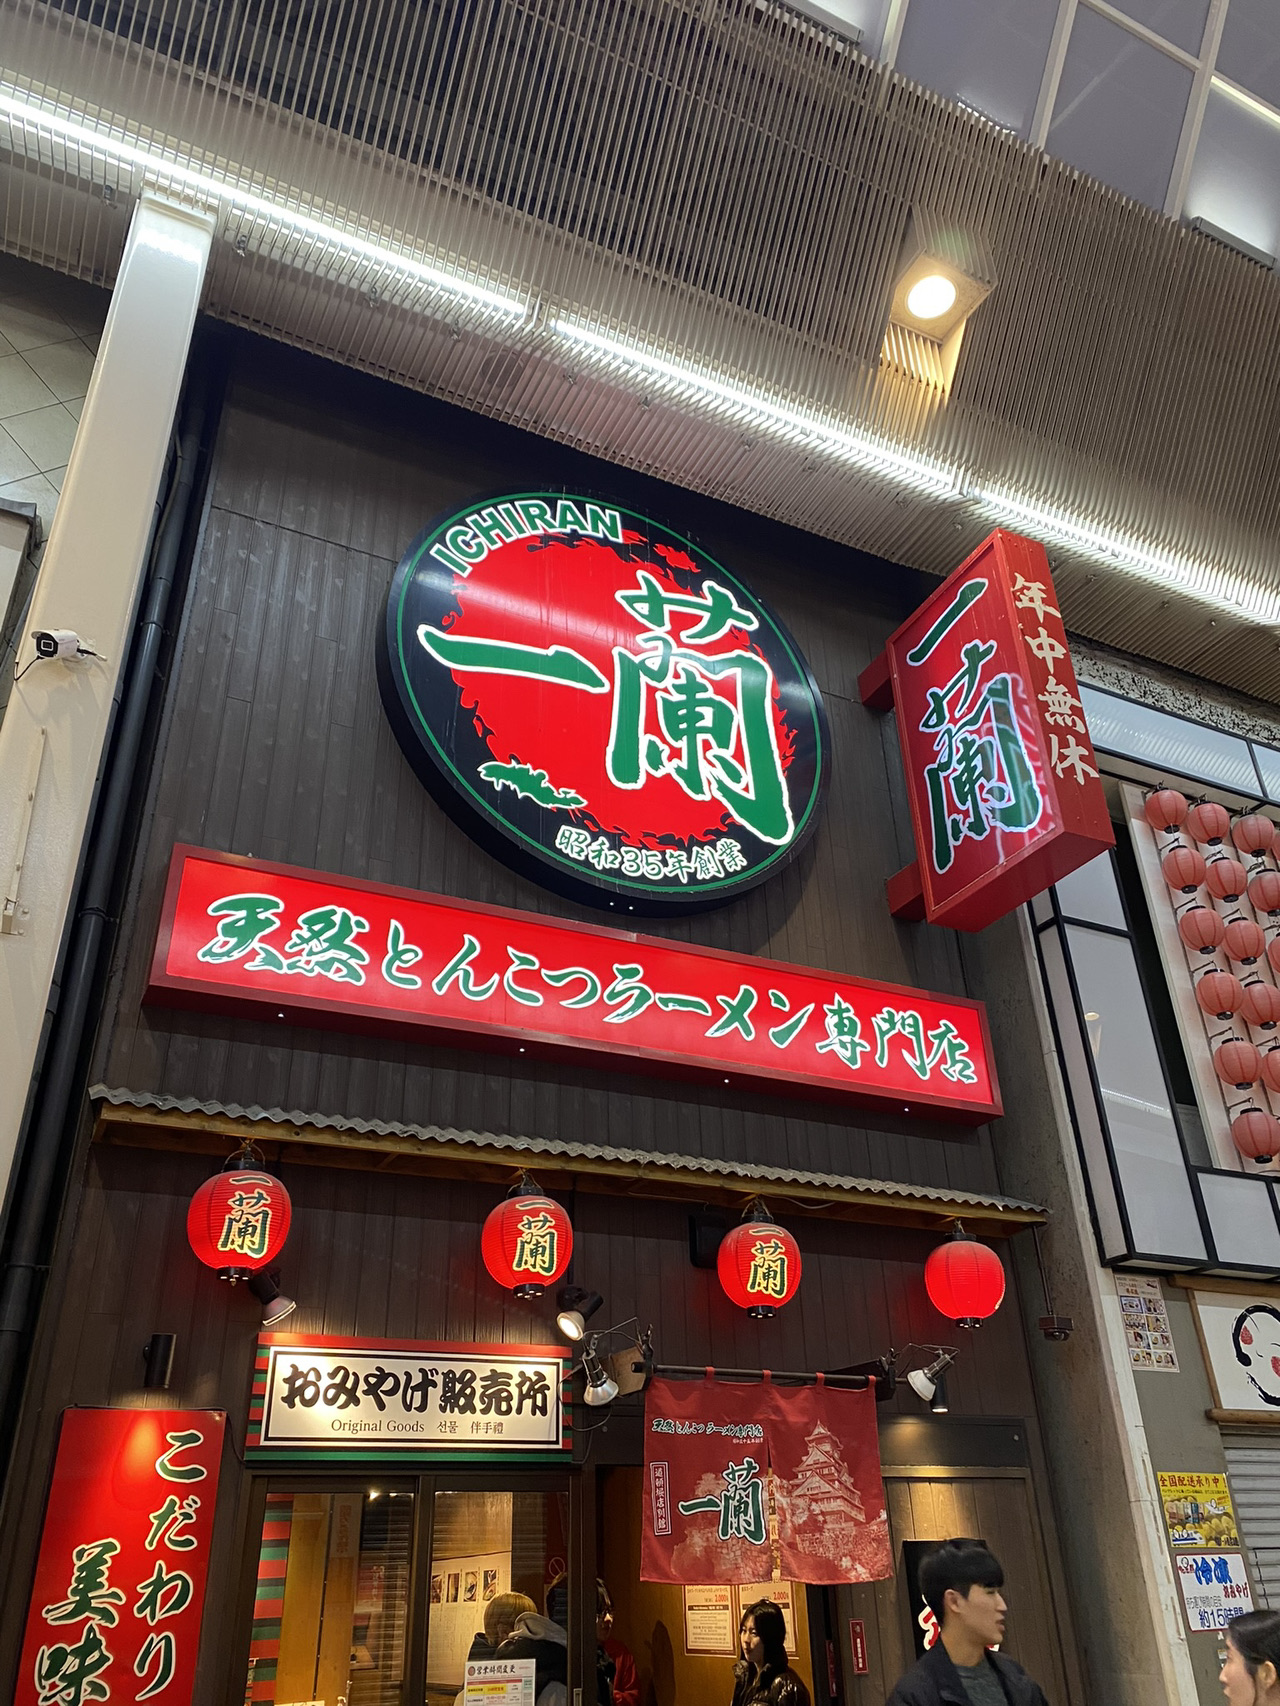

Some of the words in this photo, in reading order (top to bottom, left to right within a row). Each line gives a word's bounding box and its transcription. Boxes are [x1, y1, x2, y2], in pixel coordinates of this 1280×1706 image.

[429, 499, 623, 578] ICHIRAN
[416, 569, 795, 846] 一蘭
[1010, 572, 1100, 786] 年中無休
[906, 577, 1042, 874] 一蘭
[555, 825, 748, 884] 昭和35年創業
[196, 892, 980, 1085] 天然とんこつラーメン専門店
[217, 1175, 273, 1259] 一蘭
[511, 1199, 558, 1277] 一蘭
[746, 1226, 789, 1299] 一蘭
[281, 1363, 551, 1417] おみやげ販売所
[331, 1419, 382, 1433] Original
[386, 1420, 425, 1433] Goods
[436, 1420, 459, 1435] 선물
[470, 1421, 504, 1435] 伴手禮
[678, 1456, 767, 1545] 一蘭
[132, 1429, 207, 1702] こだわり
